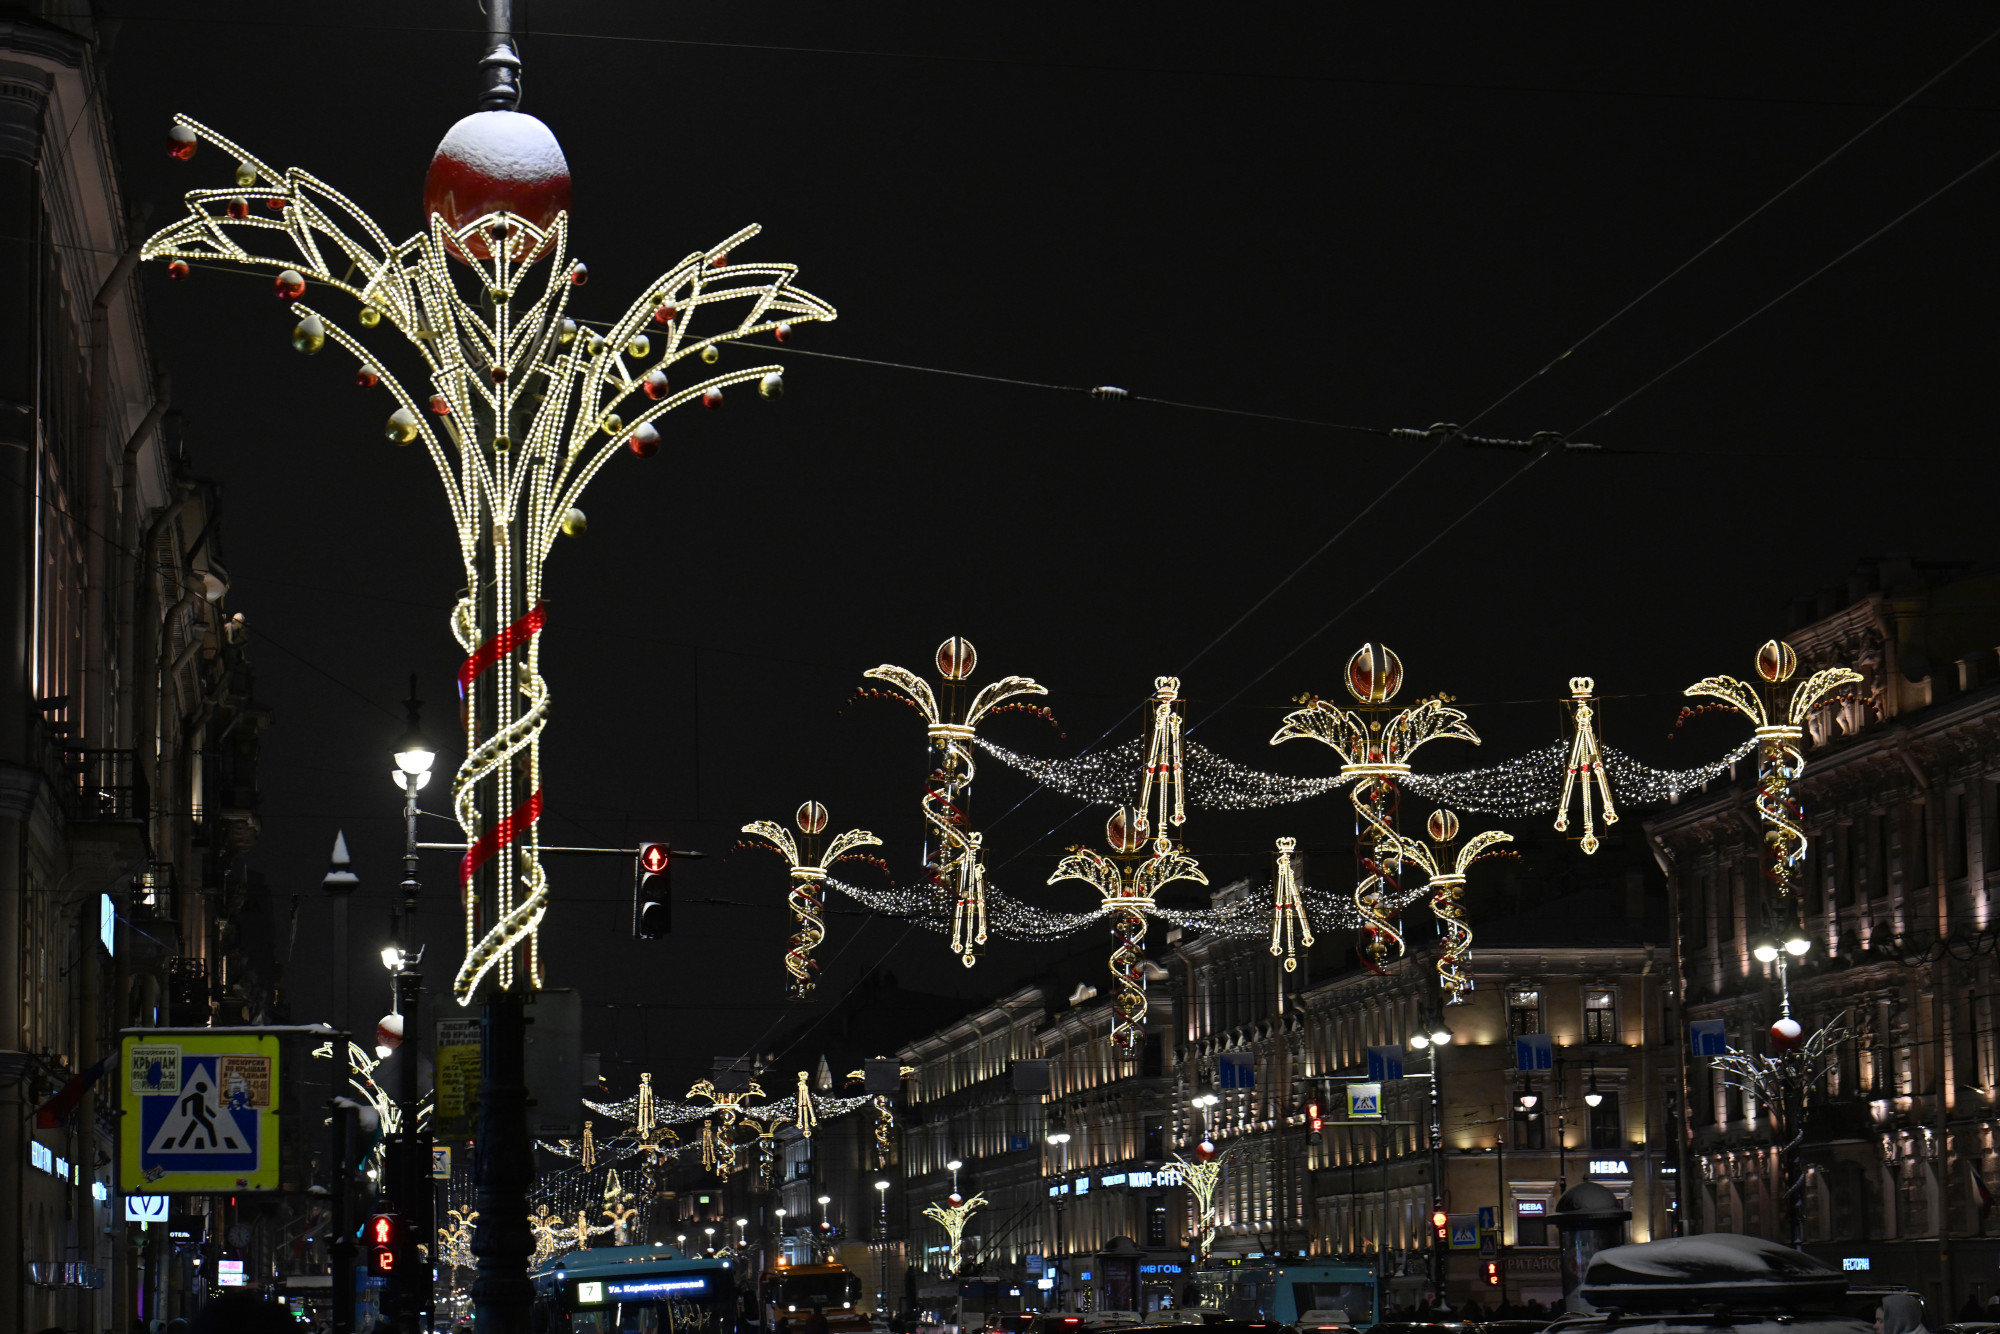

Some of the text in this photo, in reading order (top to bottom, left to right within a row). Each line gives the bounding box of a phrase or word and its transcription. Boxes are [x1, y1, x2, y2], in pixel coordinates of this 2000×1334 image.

[1589, 1160, 1629, 1173] НЕВА
[1519, 1203, 1543, 1211] НЕВА
[380, 1253, 393, 1269] 12
[1843, 1258, 1870, 1270] РЕСТОРАН
[585, 1286, 594, 1297] 7
[608, 1280, 704, 1294] Ул. Кораблестроителей
